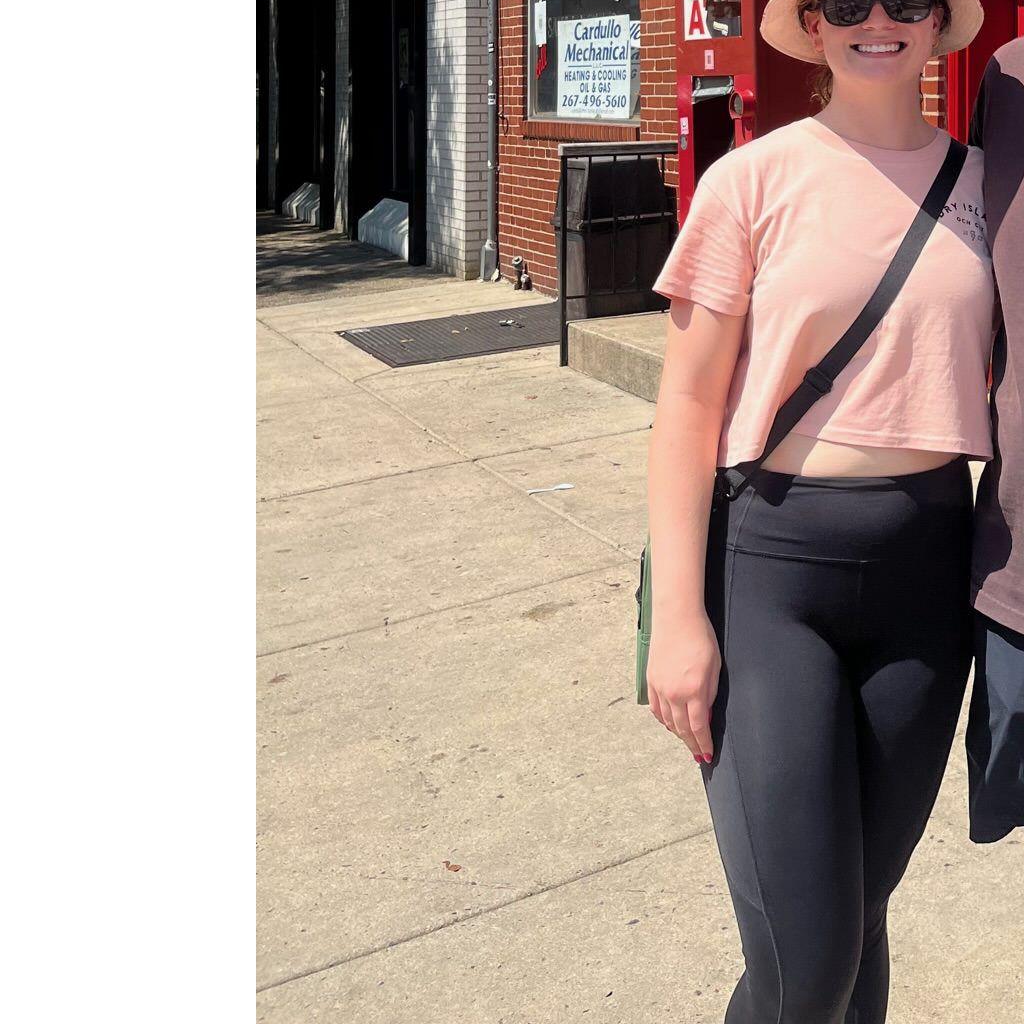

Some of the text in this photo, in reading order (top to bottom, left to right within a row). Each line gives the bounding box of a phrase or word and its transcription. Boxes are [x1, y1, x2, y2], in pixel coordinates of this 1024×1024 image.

[574, 19, 622, 41] Cardullo
[564, 40, 630, 63] Mechanical
[564, 70, 591, 82] HEATING
[592, 70, 597, 81] &
[598, 69, 627, 81] COOLING
[579, 82, 611, 93] OIL & GAS
[562, 94, 627, 108] 267-496-5610
